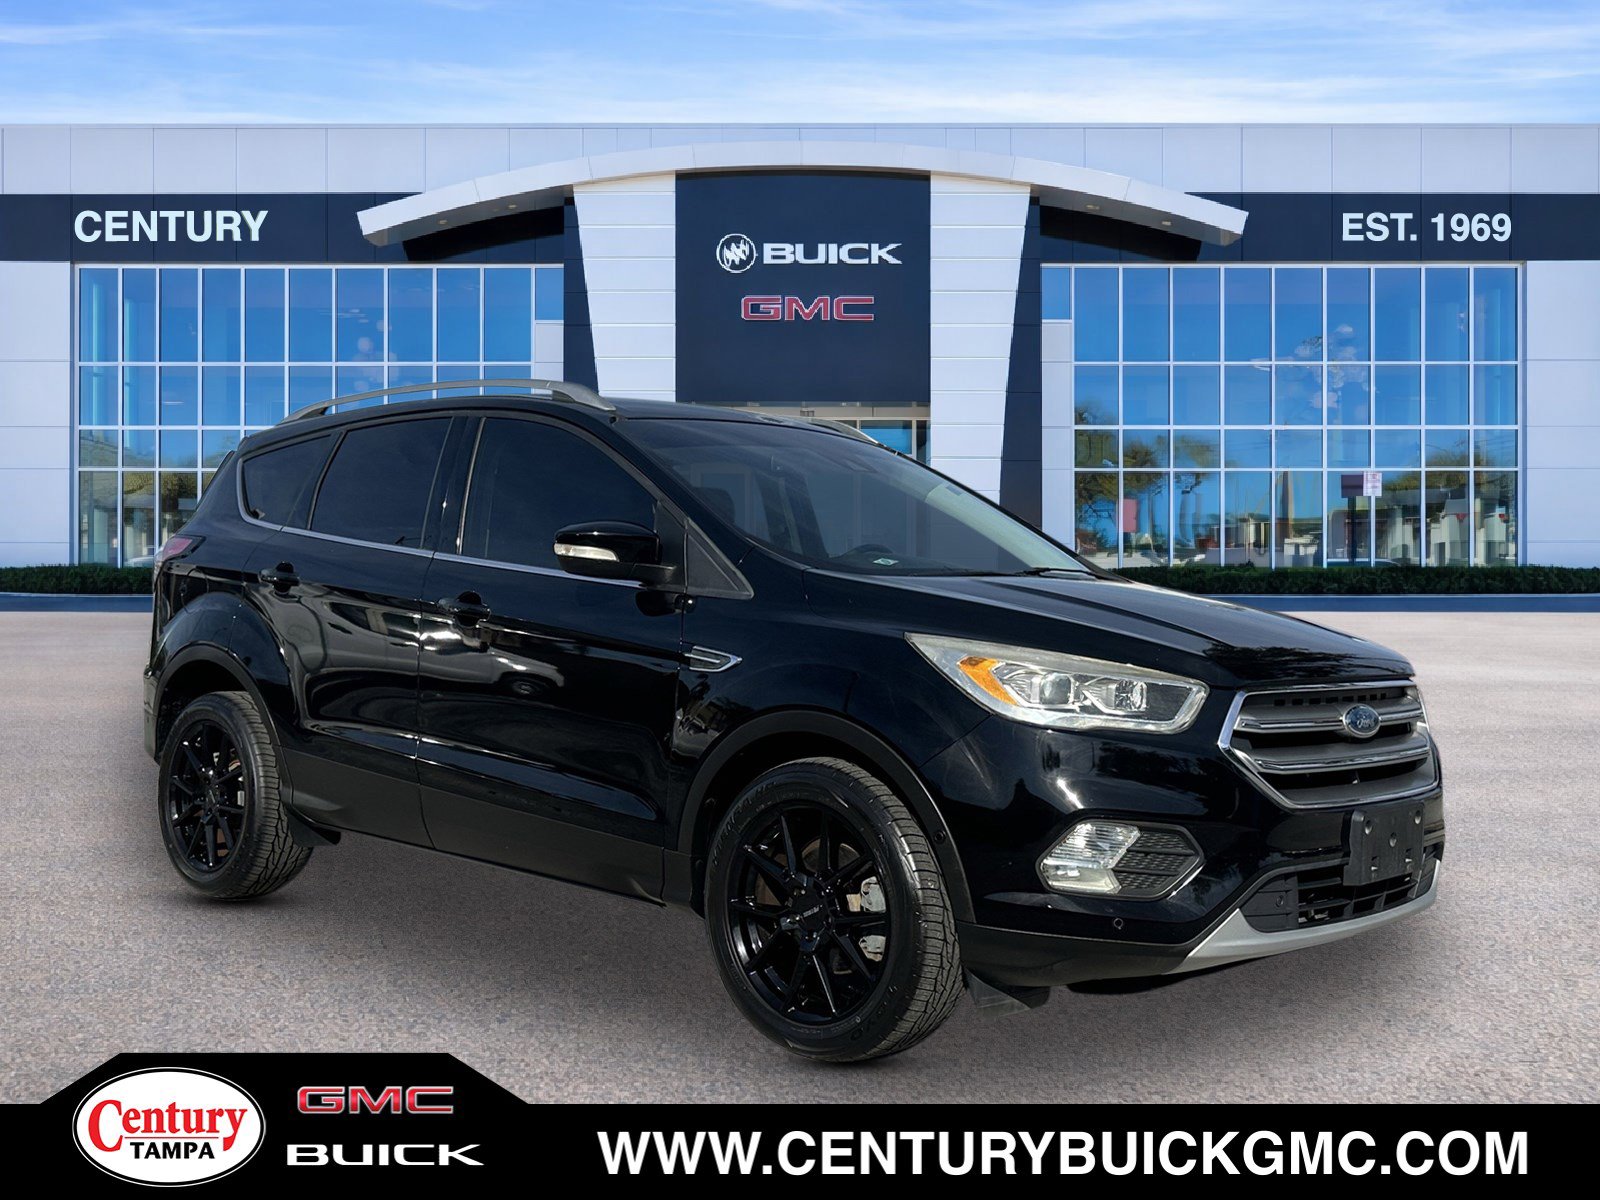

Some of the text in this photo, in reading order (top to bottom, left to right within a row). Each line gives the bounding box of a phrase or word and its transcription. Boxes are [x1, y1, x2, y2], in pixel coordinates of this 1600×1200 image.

[74, 209, 269, 243] CENTURY
[1342, 212, 1512, 242] EST. 1969
[763, 243, 903, 265] BUICK
[741, 295, 875, 321] GMC
